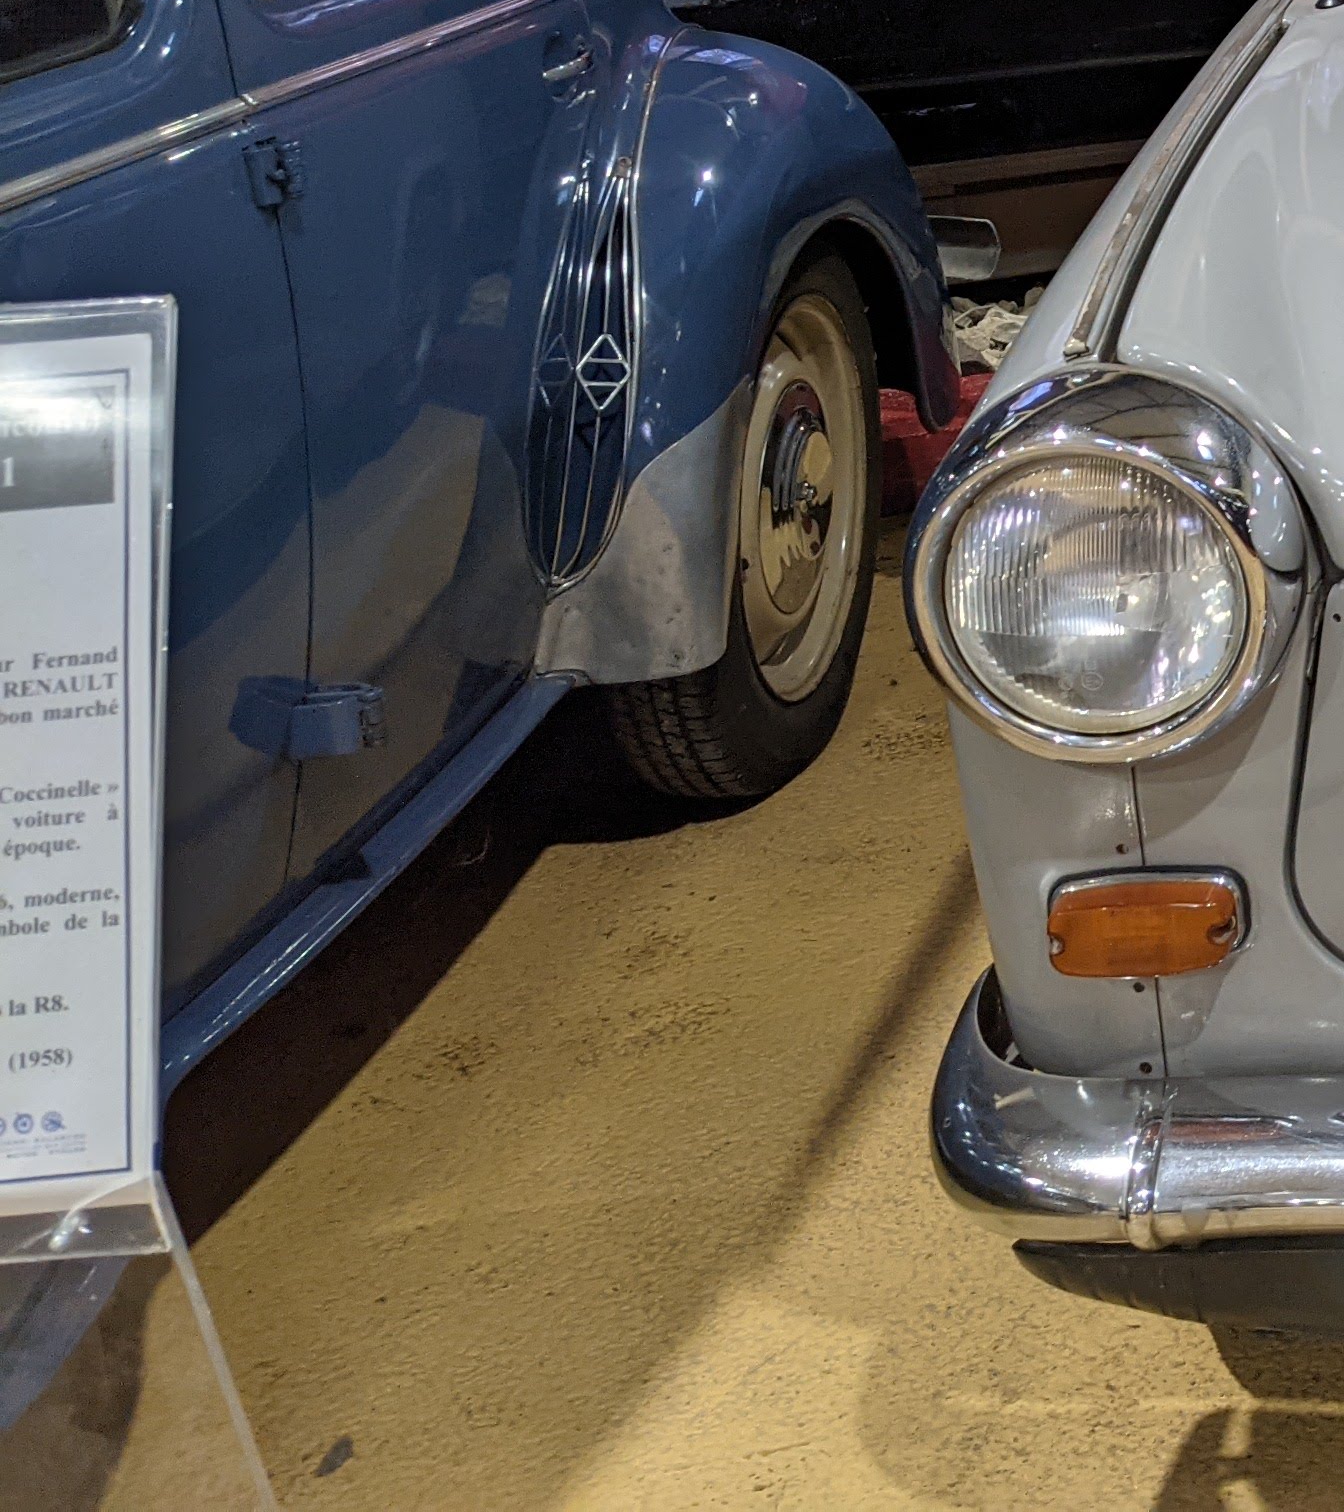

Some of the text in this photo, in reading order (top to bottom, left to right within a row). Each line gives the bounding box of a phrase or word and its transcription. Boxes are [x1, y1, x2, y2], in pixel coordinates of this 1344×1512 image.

[32, 646, 118, 670] Fernand
[3, 672, 118, 699] RENAULT
[43, 698, 119, 722] marché
[0, 779, 102, 804] Coccinelle
[12, 802, 119, 829] voiture à
[2, 839, 81, 861] époque.
[64, 913, 88, 931] de
[102, 911, 119, 928] la
[9, 999, 26, 1017] la
[35, 995, 69, 1015] R8.
[9, 1048, 73, 1073] (1958)
